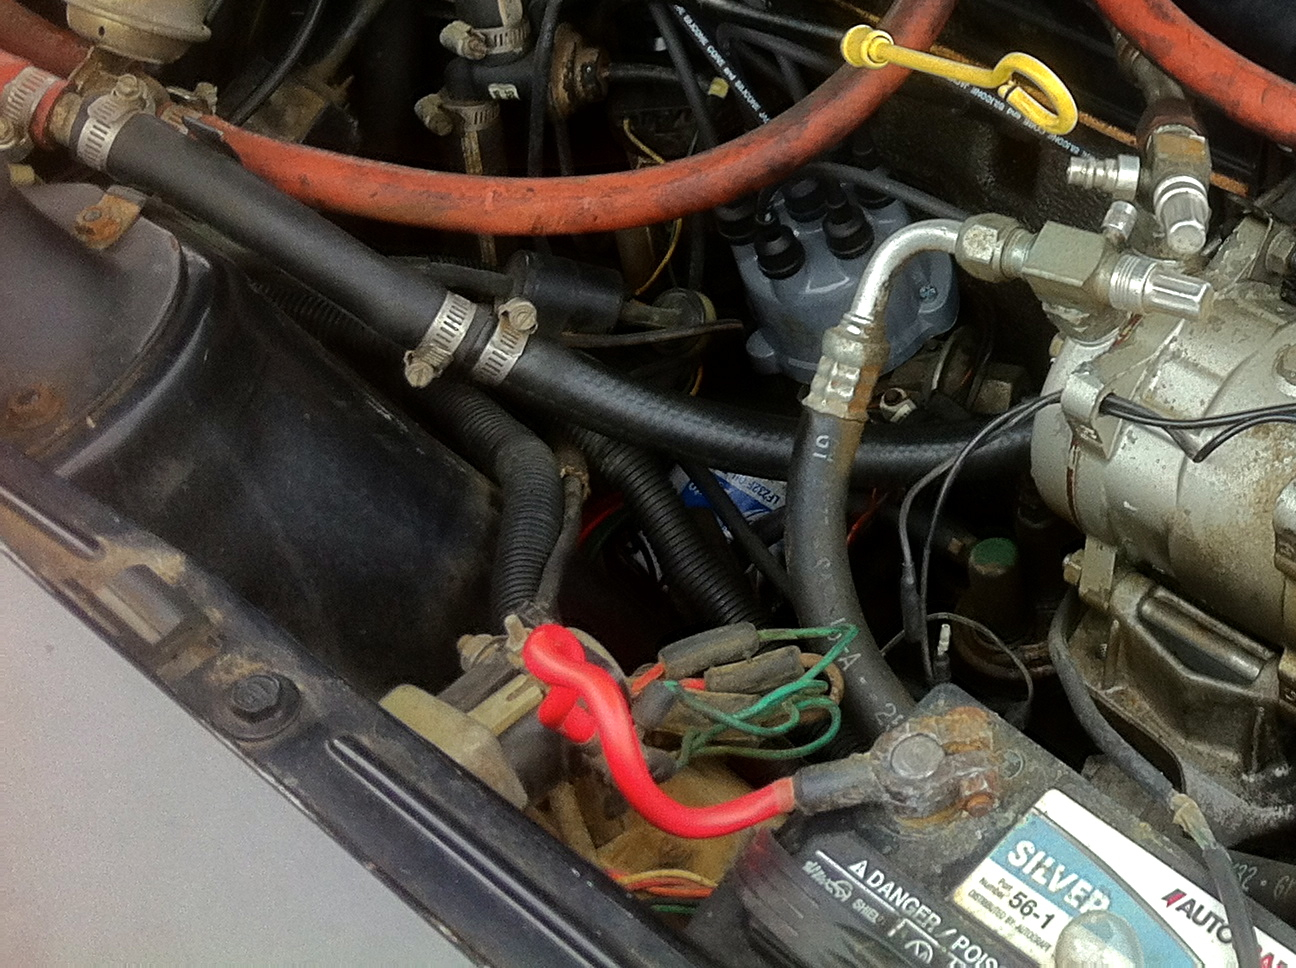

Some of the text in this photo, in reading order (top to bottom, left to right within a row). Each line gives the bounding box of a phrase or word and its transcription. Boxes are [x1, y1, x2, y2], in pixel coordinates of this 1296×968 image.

[867, 869, 941, 931] DANGER
[1007, 840, 1111, 914] SILVER
[1008, 890, 1056, 930] 56-1
